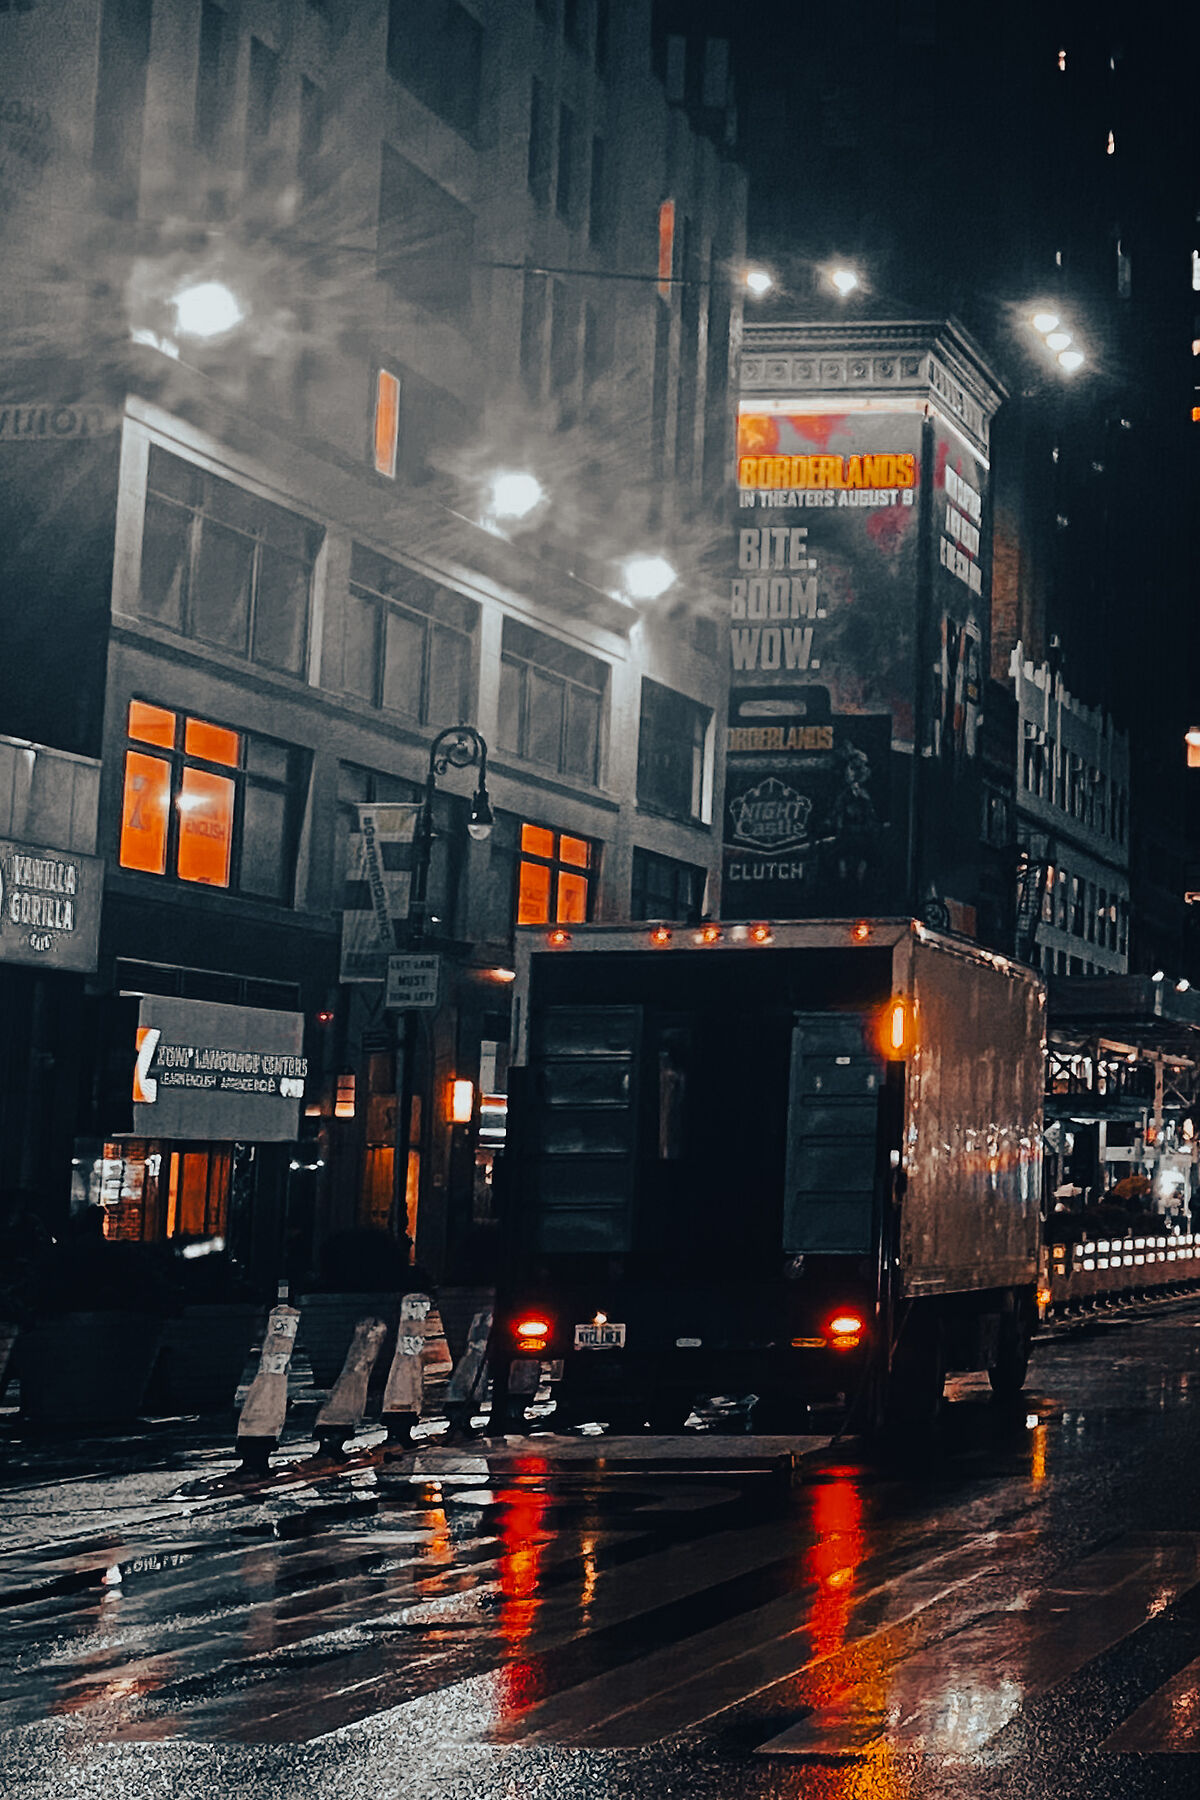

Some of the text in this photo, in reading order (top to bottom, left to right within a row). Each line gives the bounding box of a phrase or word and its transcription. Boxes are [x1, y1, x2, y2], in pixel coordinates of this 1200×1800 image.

[738, 454, 915, 489] BORDERLANDS
[739, 490, 756, 508] IN
[759, 490, 835, 508] THEATERS
[838, 489, 899, 507] AUGUST
[738, 527, 818, 570] BITE.
[730, 577, 828, 620] BOOM.
[730, 626, 822, 671] WOW.
[740, 800, 801, 820] NIGHT
[736, 818, 806, 837] Castle
[13, 855, 76, 894] VANILLA
[729, 862, 803, 881] CLUTCH
[10, 892, 74, 930] GORILLA
[391, 959, 413, 971] LEFT
[398, 975, 427, 987] MUST
